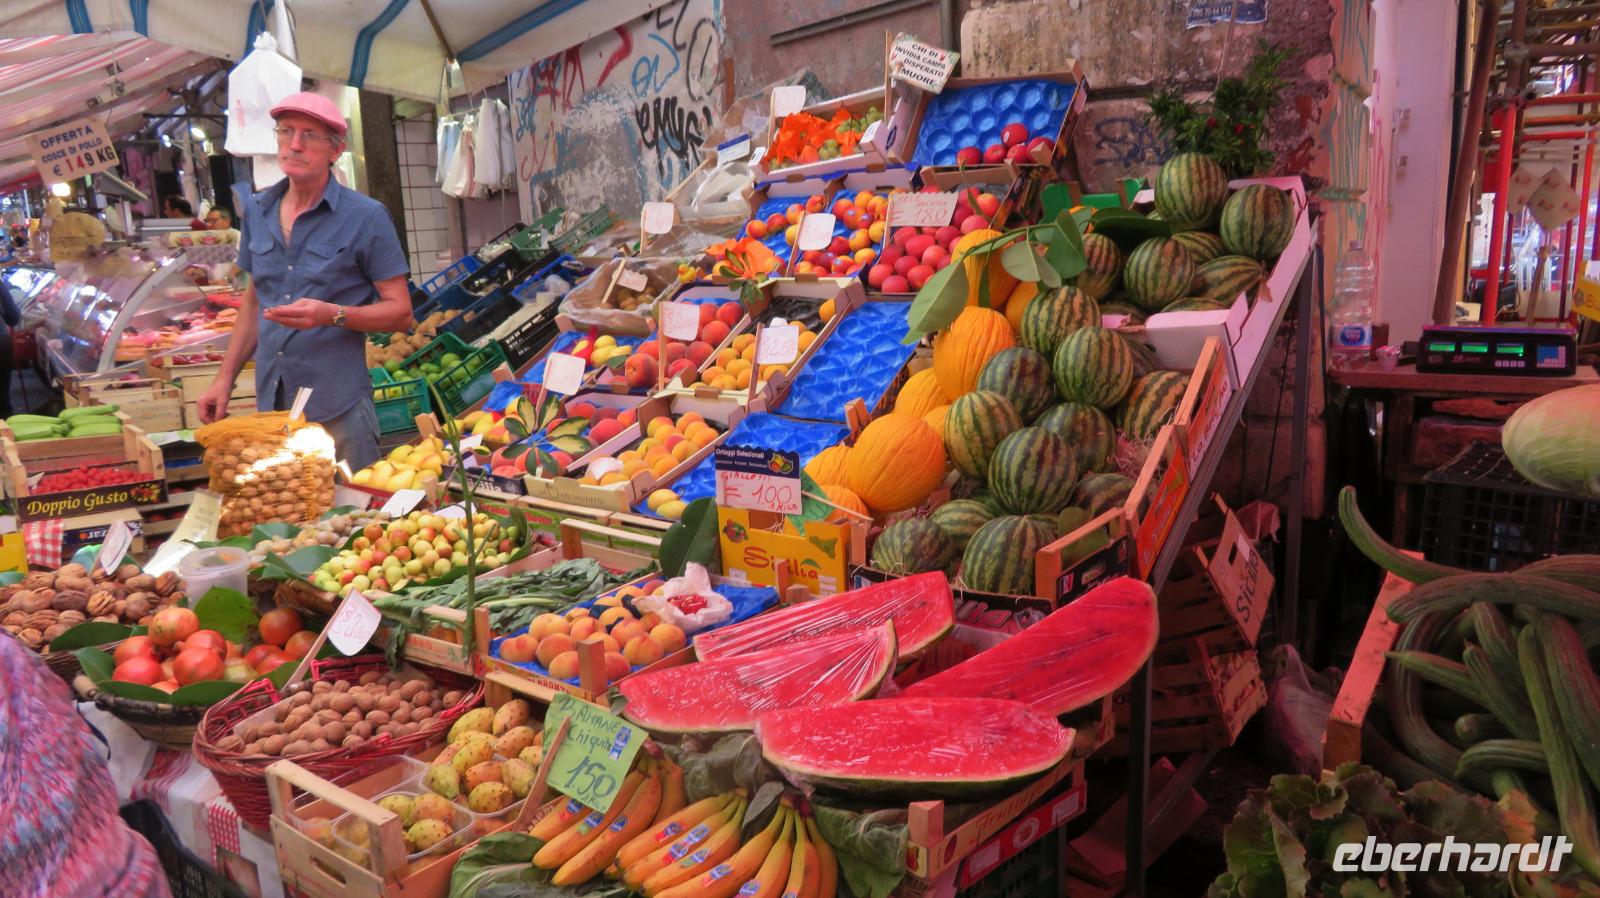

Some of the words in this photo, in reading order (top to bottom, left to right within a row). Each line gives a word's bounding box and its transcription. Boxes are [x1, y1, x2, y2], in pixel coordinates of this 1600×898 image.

[895, 45, 921, 61] INVIDIA
[922, 57, 947, 69] CAMPA
[911, 43, 928, 54] CHI
[929, 50, 939, 58] DI
[903, 58, 945, 78] DISPERATO
[40, 125, 94, 149] OFFERTA
[41, 150, 67, 163] COSCE
[78, 137, 103, 151] POLLO
[95, 146, 116, 163] KG
[715, 448, 736, 459] Ortaggi
[736, 449, 765, 460] Selezionati
[27, 495, 81, 517] Doppio
[84, 490, 128, 511] Gusto
[743, 546, 818, 580] Siilia
